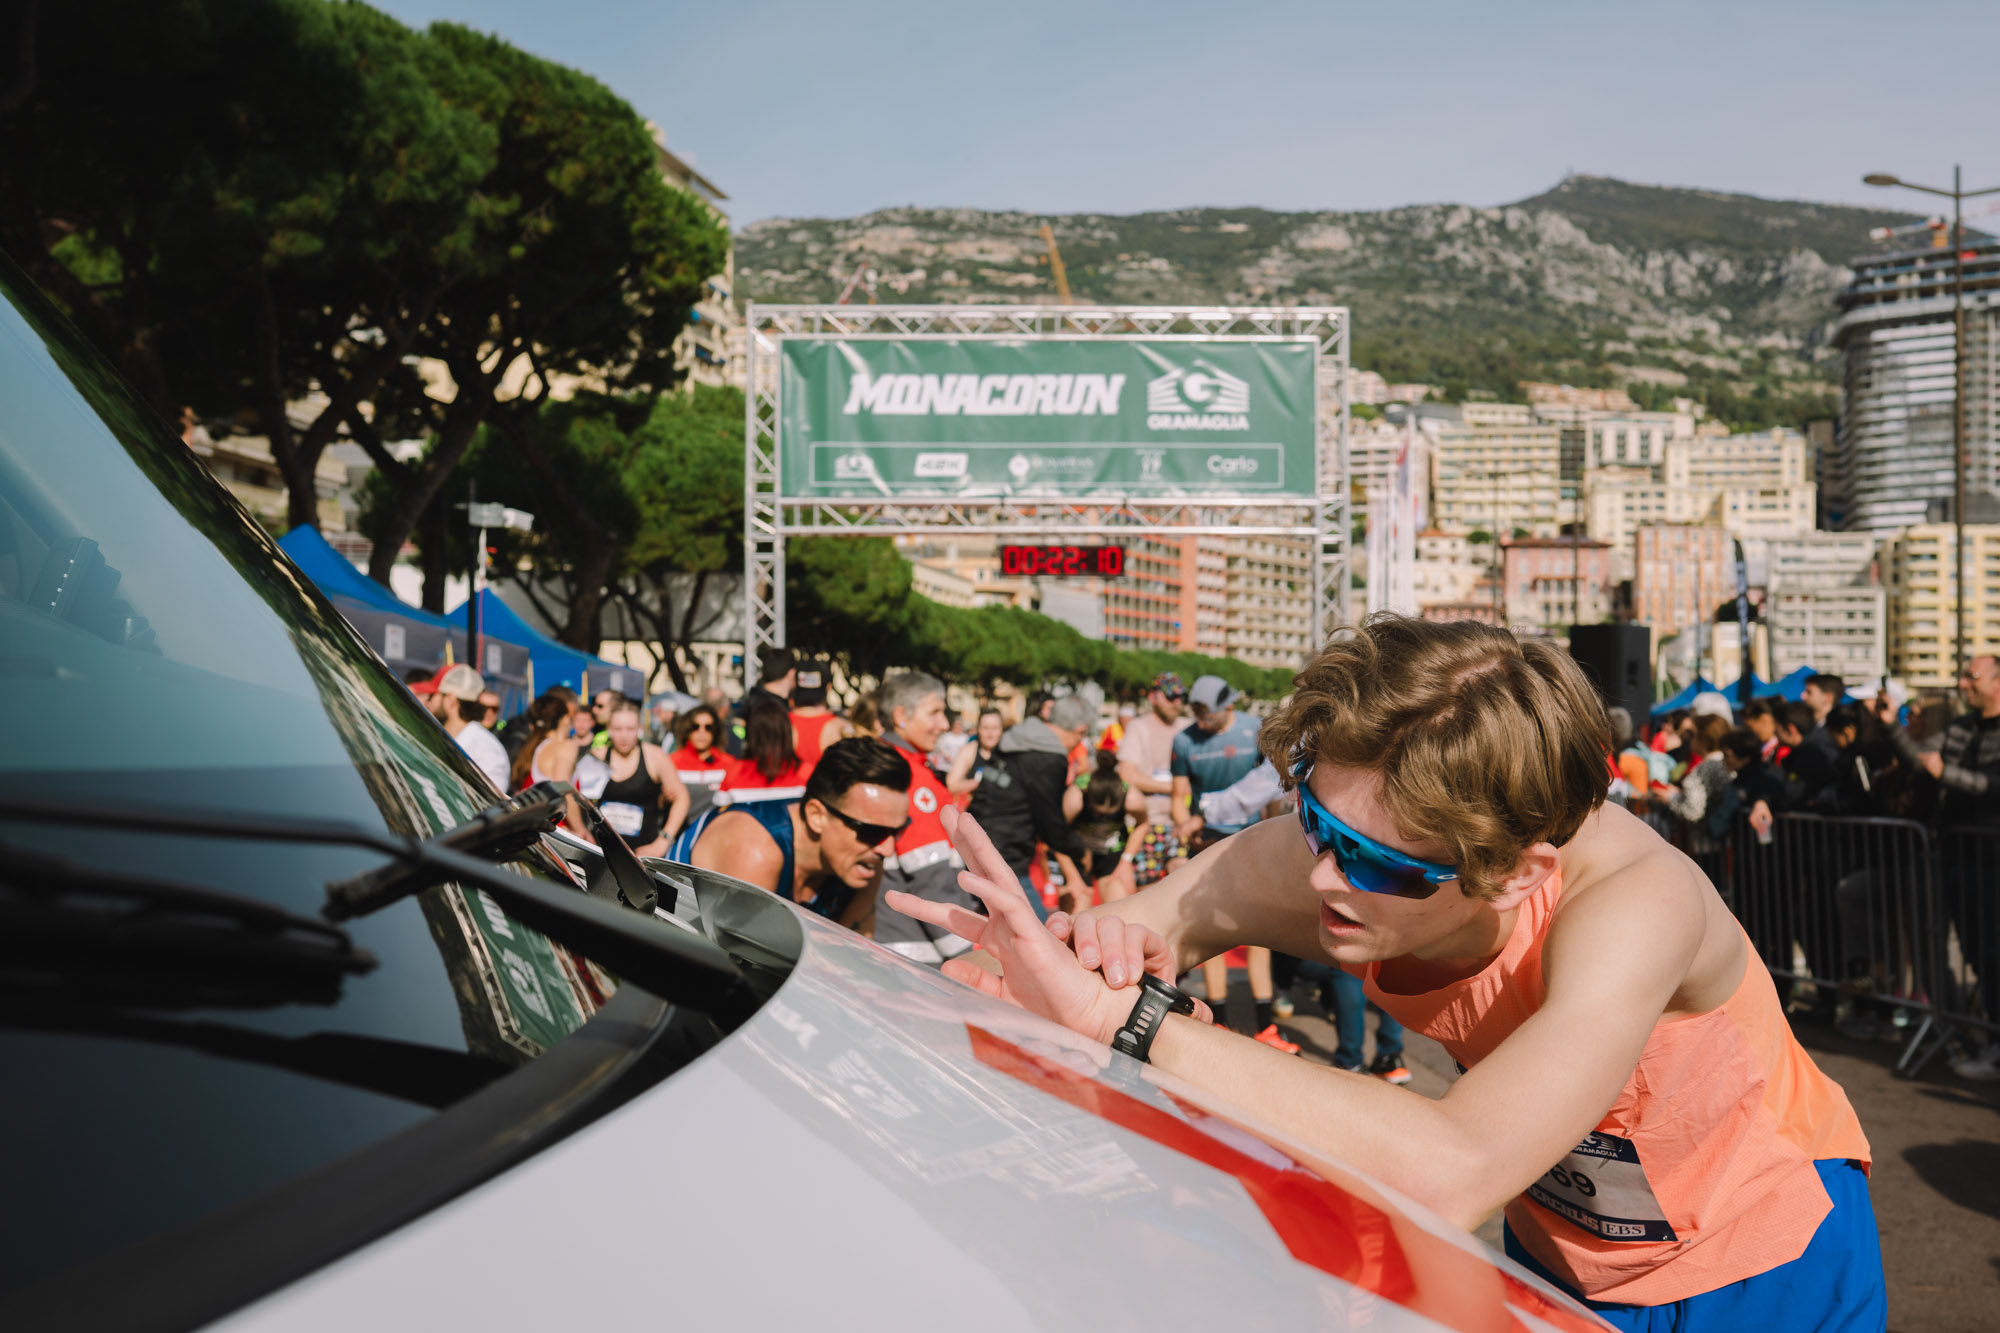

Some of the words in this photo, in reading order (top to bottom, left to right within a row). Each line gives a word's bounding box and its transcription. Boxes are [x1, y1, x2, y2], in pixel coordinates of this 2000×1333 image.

[844, 374, 1126, 415] MONACORUN
[1147, 413, 1250, 431] GRAMAGLIA
[1606, 1223, 1642, 1235] EBS
